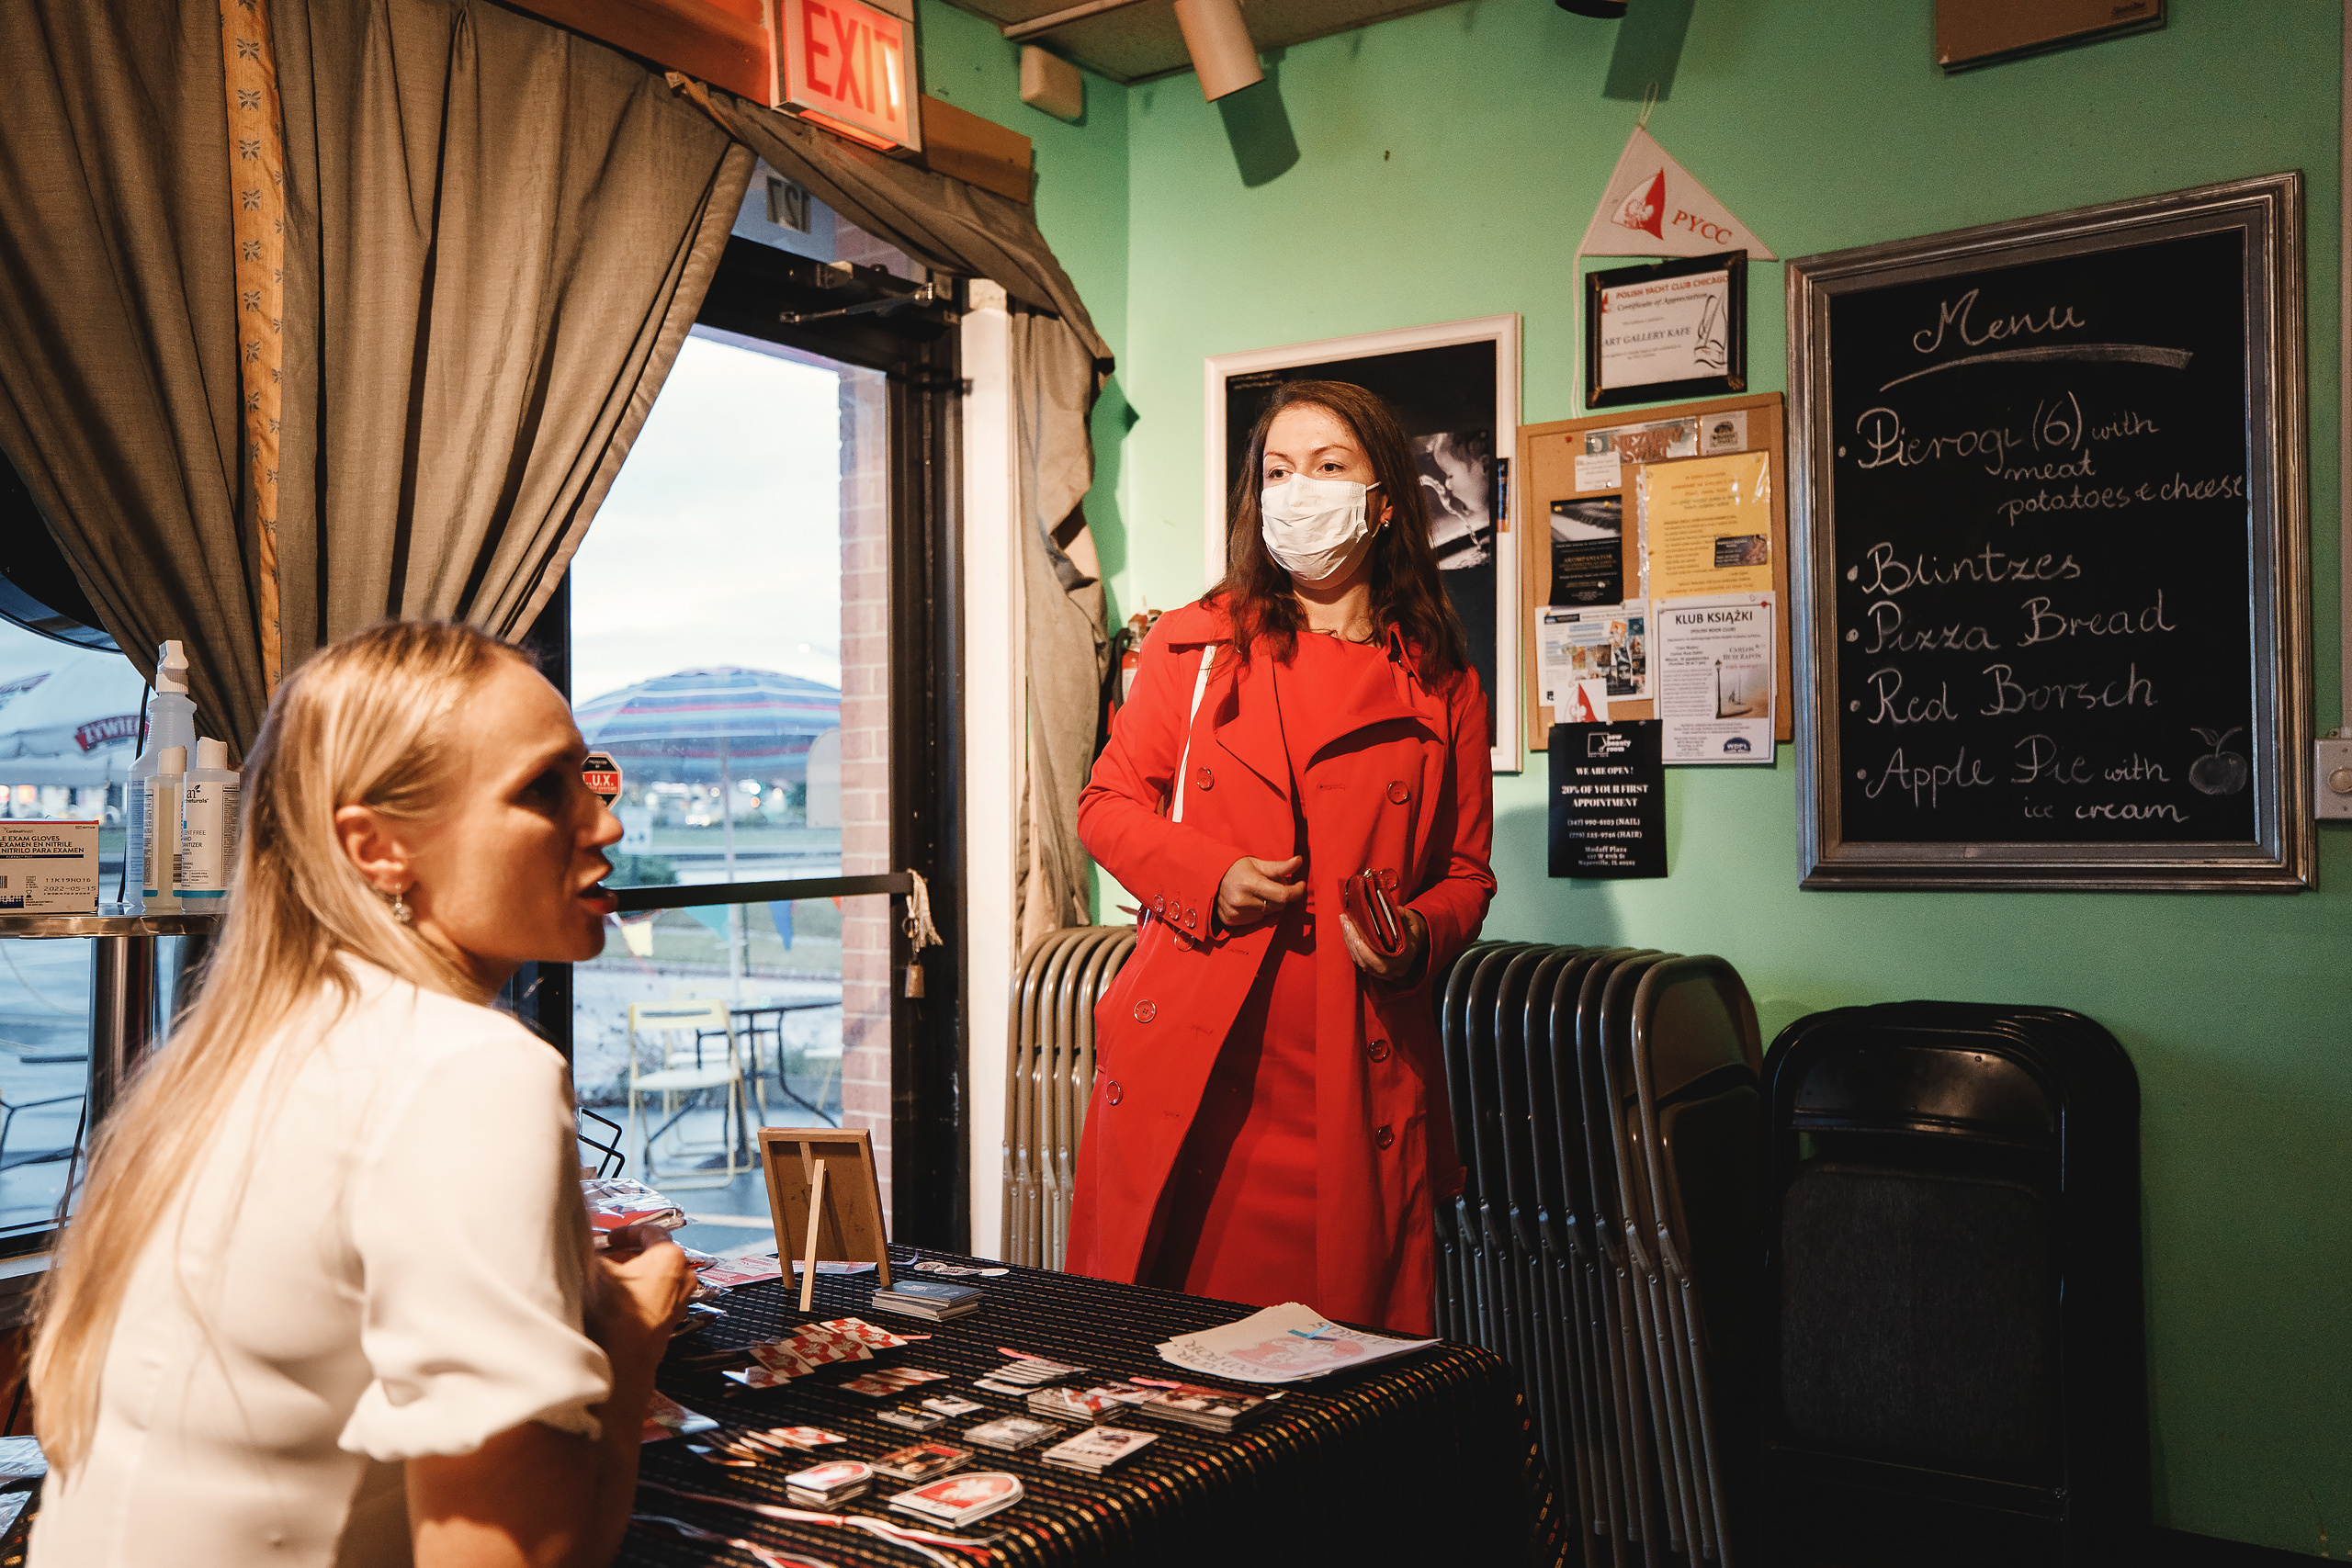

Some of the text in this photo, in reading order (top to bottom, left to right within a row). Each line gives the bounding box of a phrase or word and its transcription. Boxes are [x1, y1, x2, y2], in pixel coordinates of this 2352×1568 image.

[801, 0, 899, 122] EXIT
[1671, 209, 1732, 244] PYCC
[1615, 275, 1728, 299] POLISH YACHT CLUB CHICAGO
[1913, 288, 2085, 353] Menu
[1602, 326, 1690, 347] ART GALLERY KAFE
[1856, 390, 2159, 475] Pierogi (6) with
[2005, 448, 2097, 480] meat
[1997, 484, 2131, 526] potatoes
[2160, 472, 2245, 501] cheese
[1861, 541, 2081, 595] Blintzes
[1675, 609, 1753, 625] KLUB KSIĄŻKI
[1865, 589, 2177, 654] Pizza Bread
[1867, 662, 2158, 724] Red Borsch
[1606, 739, 1632, 748] beauty
[1576, 767, 1589, 775] WE
[1590, 766, 1607, 775] ARE
[1607, 766, 1629, 774] OPEN
[1865, 734, 2170, 808] Apple Pie with
[1561, 784, 1649, 795] 20% OF YOUR FIRST
[1573, 797, 1638, 807] APPOINTMENT
[1615, 817, 1641, 827] (NAIL)
[2023, 796, 2190, 823] ice cream
[1617, 830, 1643, 839] (HAIR)
